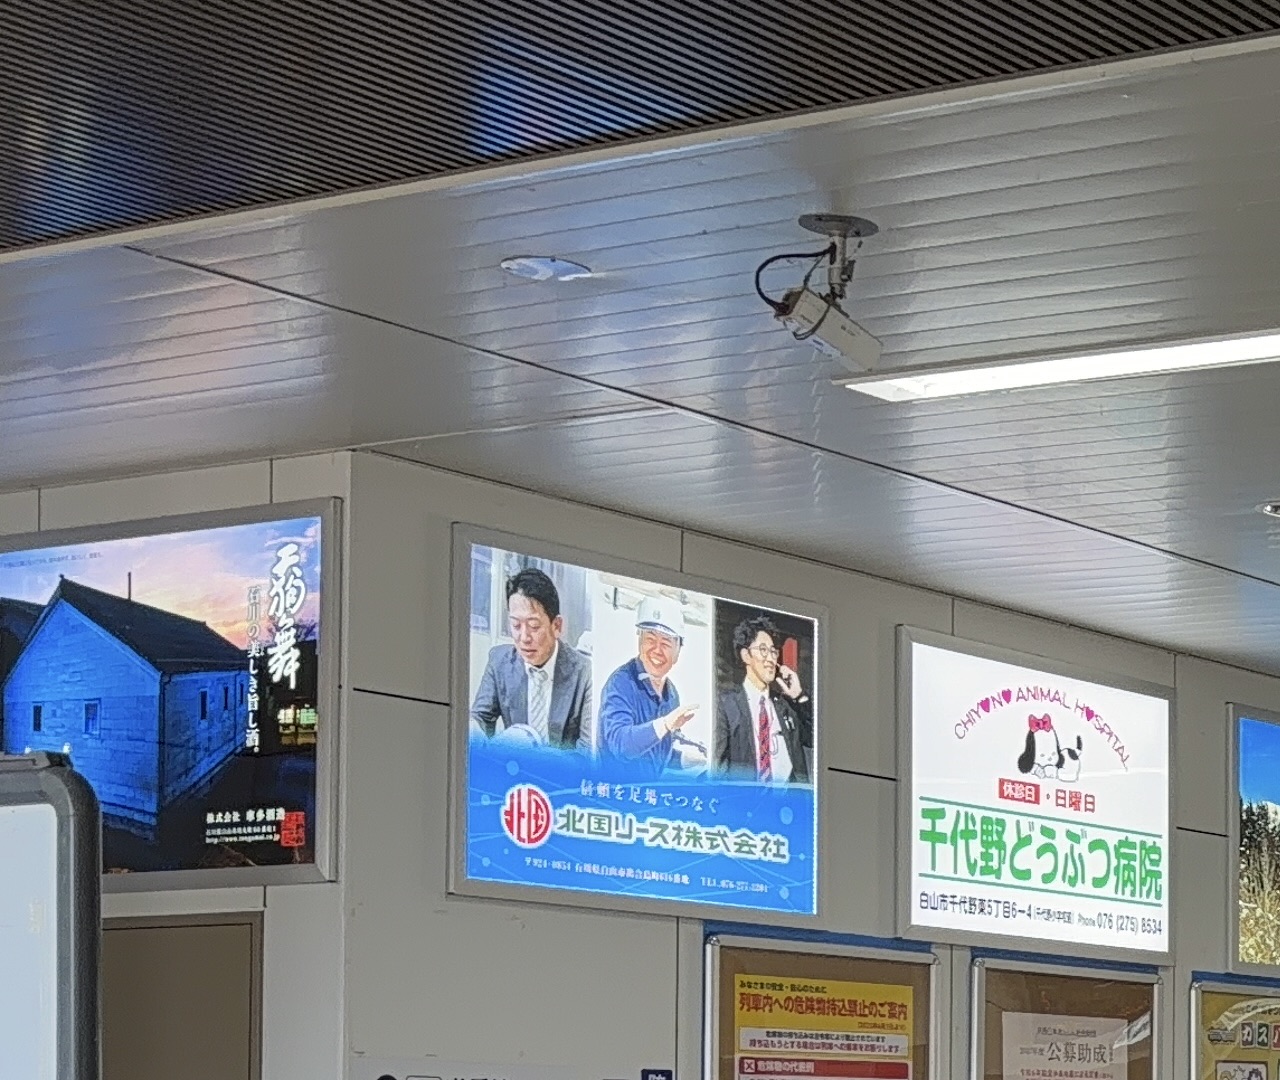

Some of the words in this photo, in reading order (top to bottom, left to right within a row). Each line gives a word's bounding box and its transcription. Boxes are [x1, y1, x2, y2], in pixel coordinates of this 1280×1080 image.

[1016, 686, 1071, 709] ANIMAL
[557, 808, 789, 862] 北国リース株式会社
[919, 807, 1163, 900] 千代野どうぶつ病院
